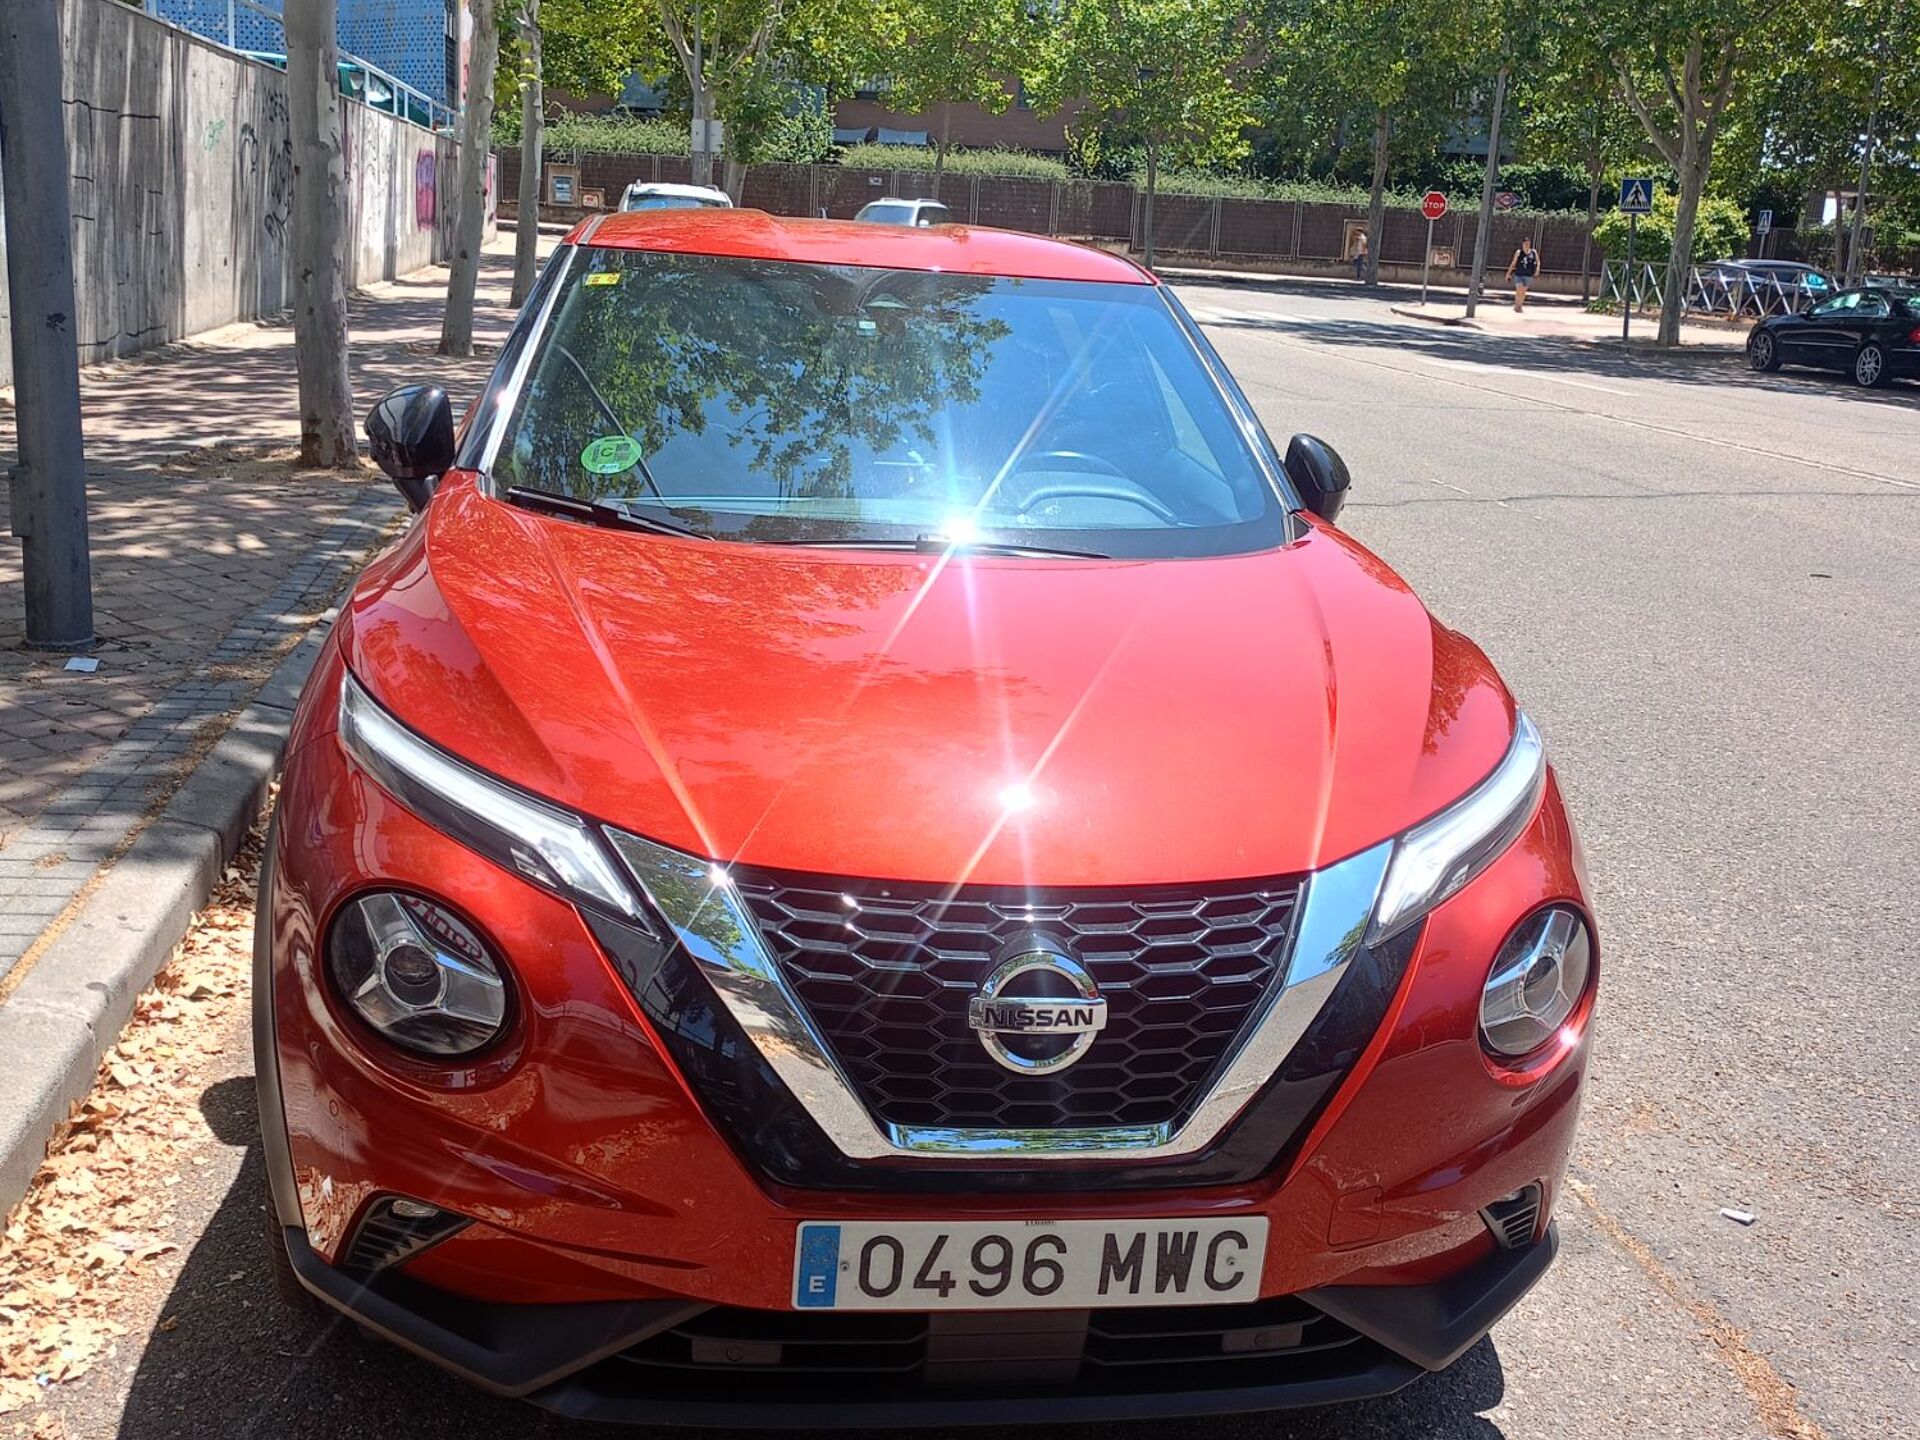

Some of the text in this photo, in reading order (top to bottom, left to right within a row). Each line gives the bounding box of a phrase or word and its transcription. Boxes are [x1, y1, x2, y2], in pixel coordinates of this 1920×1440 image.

[1424, 201, 1445, 209] STOP
[601, 447, 614, 456] C
[985, 1008, 1093, 1027] NISSAN
[858, 1230, 1249, 1298] 0496 MWC
[808, 1275, 826, 1293] E
